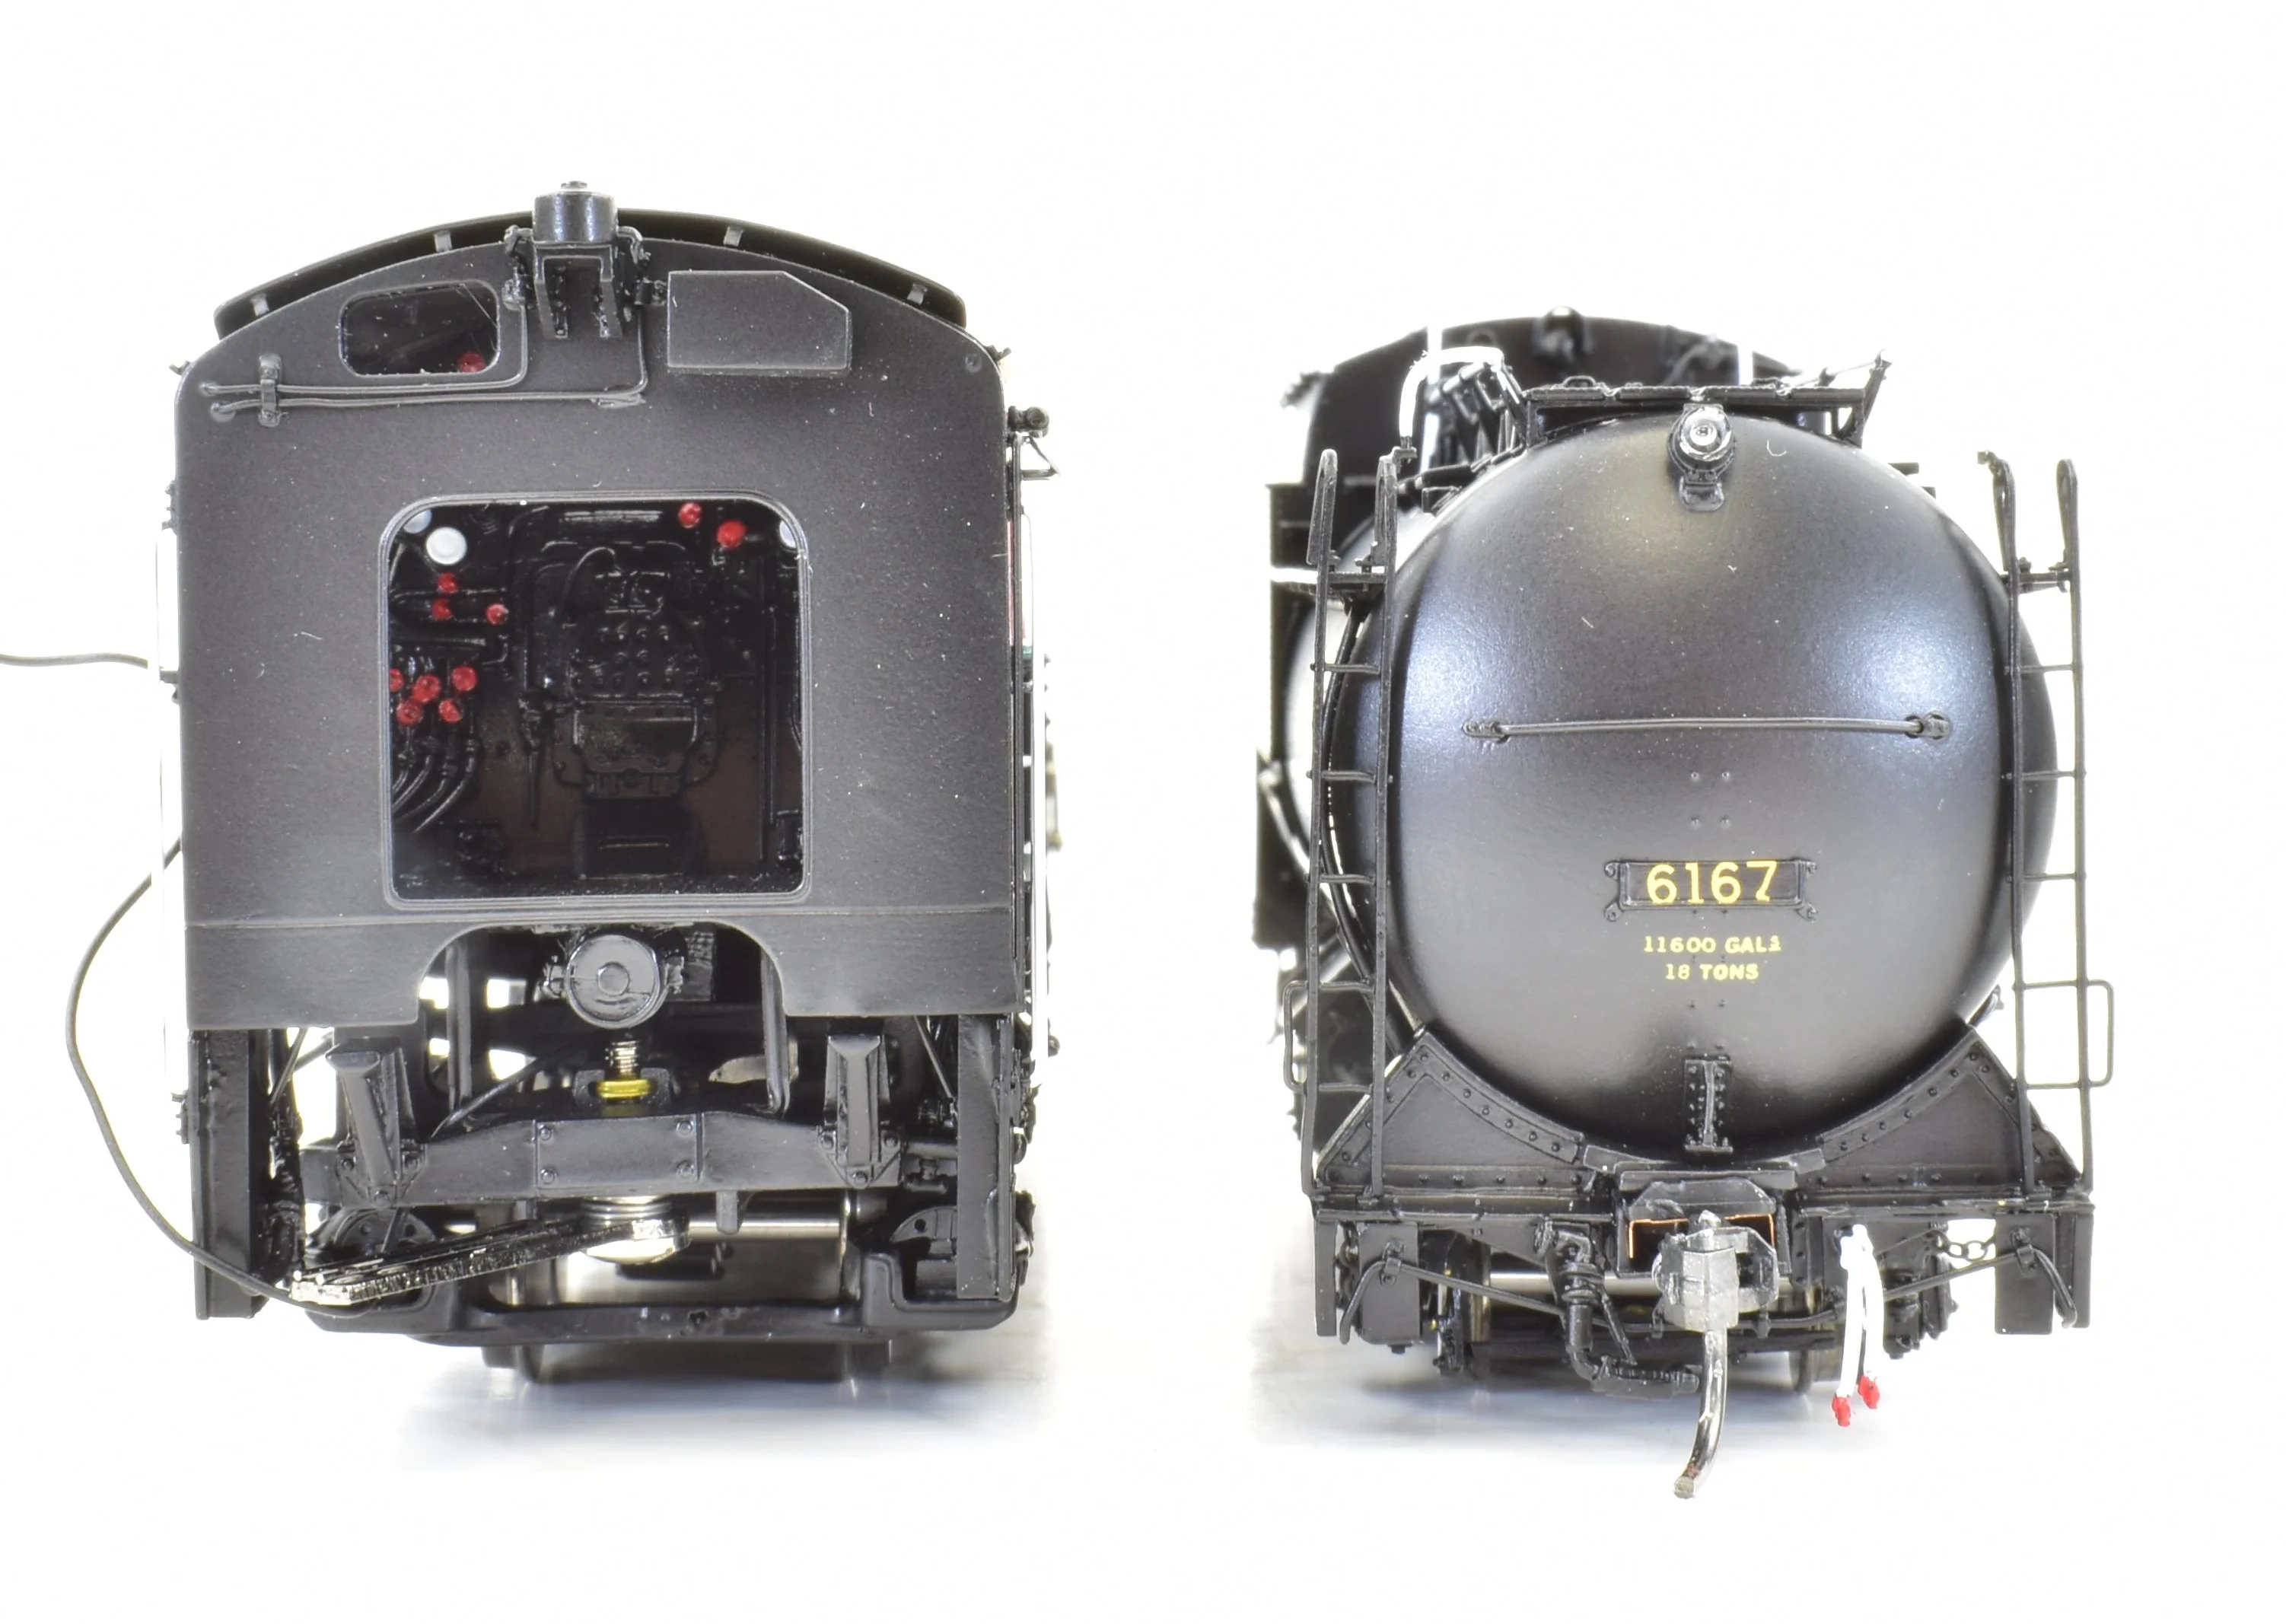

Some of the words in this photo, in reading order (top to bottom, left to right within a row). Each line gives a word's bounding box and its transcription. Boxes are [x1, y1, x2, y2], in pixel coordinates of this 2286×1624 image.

[1646, 860, 1778, 905] 6167
[1644, 936, 1717, 954] 11600
[1666, 963, 1691, 981] 18
[1699, 963, 1760, 982] TONS
